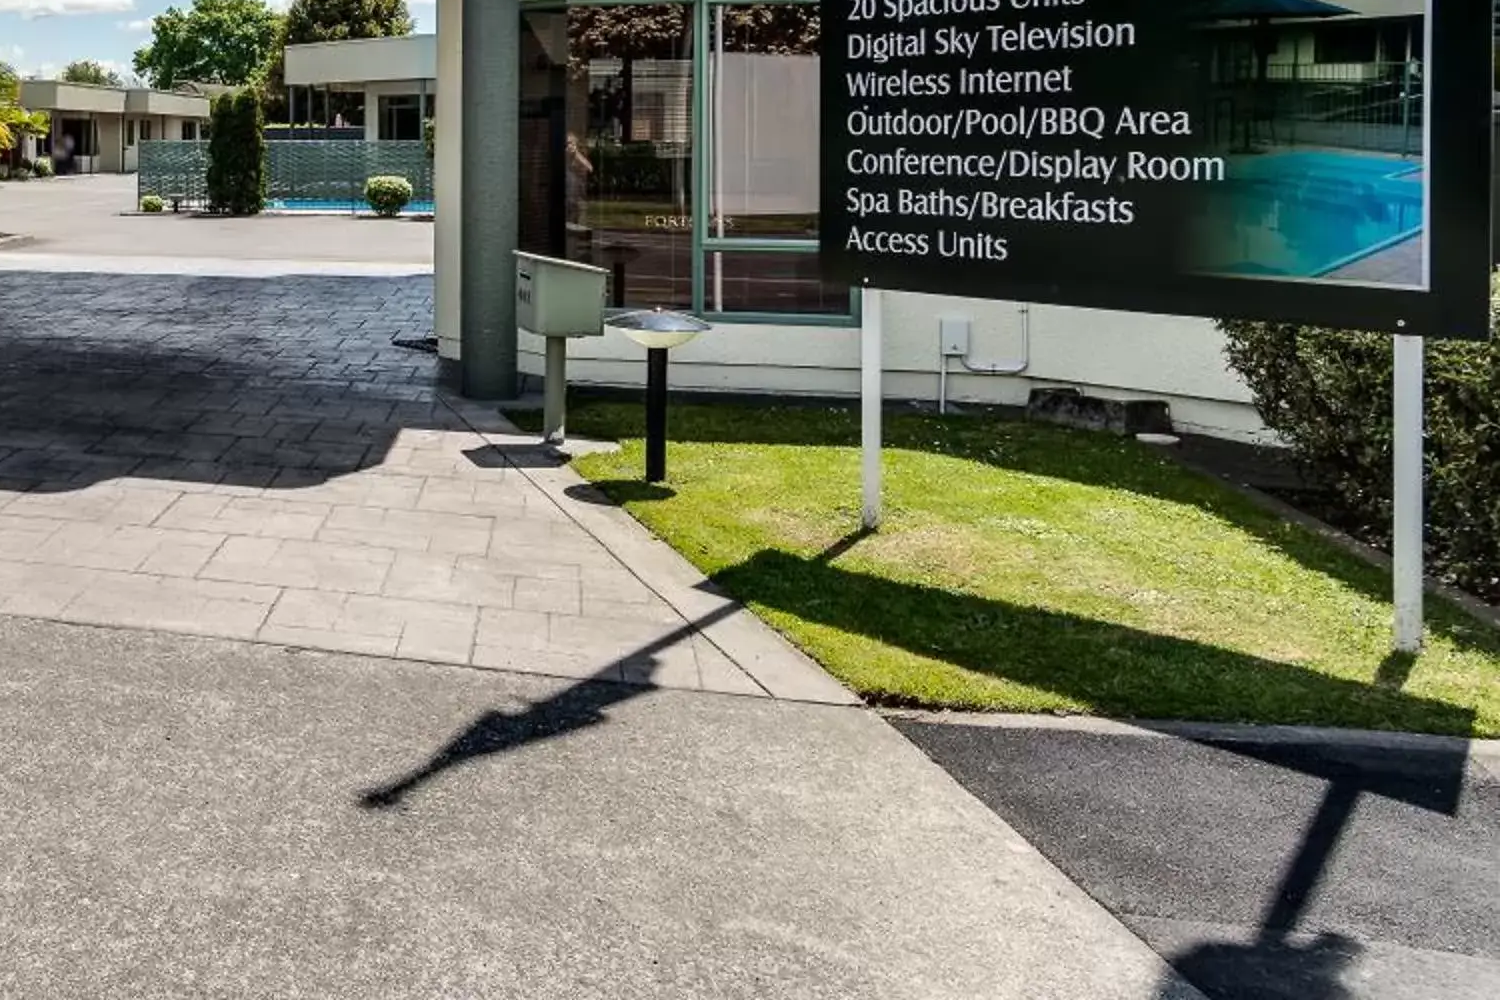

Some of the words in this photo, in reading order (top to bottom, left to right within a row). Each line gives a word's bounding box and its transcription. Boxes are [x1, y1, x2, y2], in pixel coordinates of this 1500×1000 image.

[847, 28, 926, 63] Digital
[935, 26, 980, 58] Sky
[986, 20, 1136, 53] Television
[846, 68, 951, 98] Wireless
[960, 65, 1072, 95] Internet
[847, 106, 1106, 139] Outdoor/Pool/BBQ
[1115, 106, 1193, 135] Area
[847, 147, 1116, 184] Conference/Display
[1128, 151, 1224, 181] Room
[846, 187, 890, 218] Spa
[899, 188, 1134, 224] Baths/Breakfasts
[846, 225, 929, 256] Access
[938, 230, 1008, 261] Units
